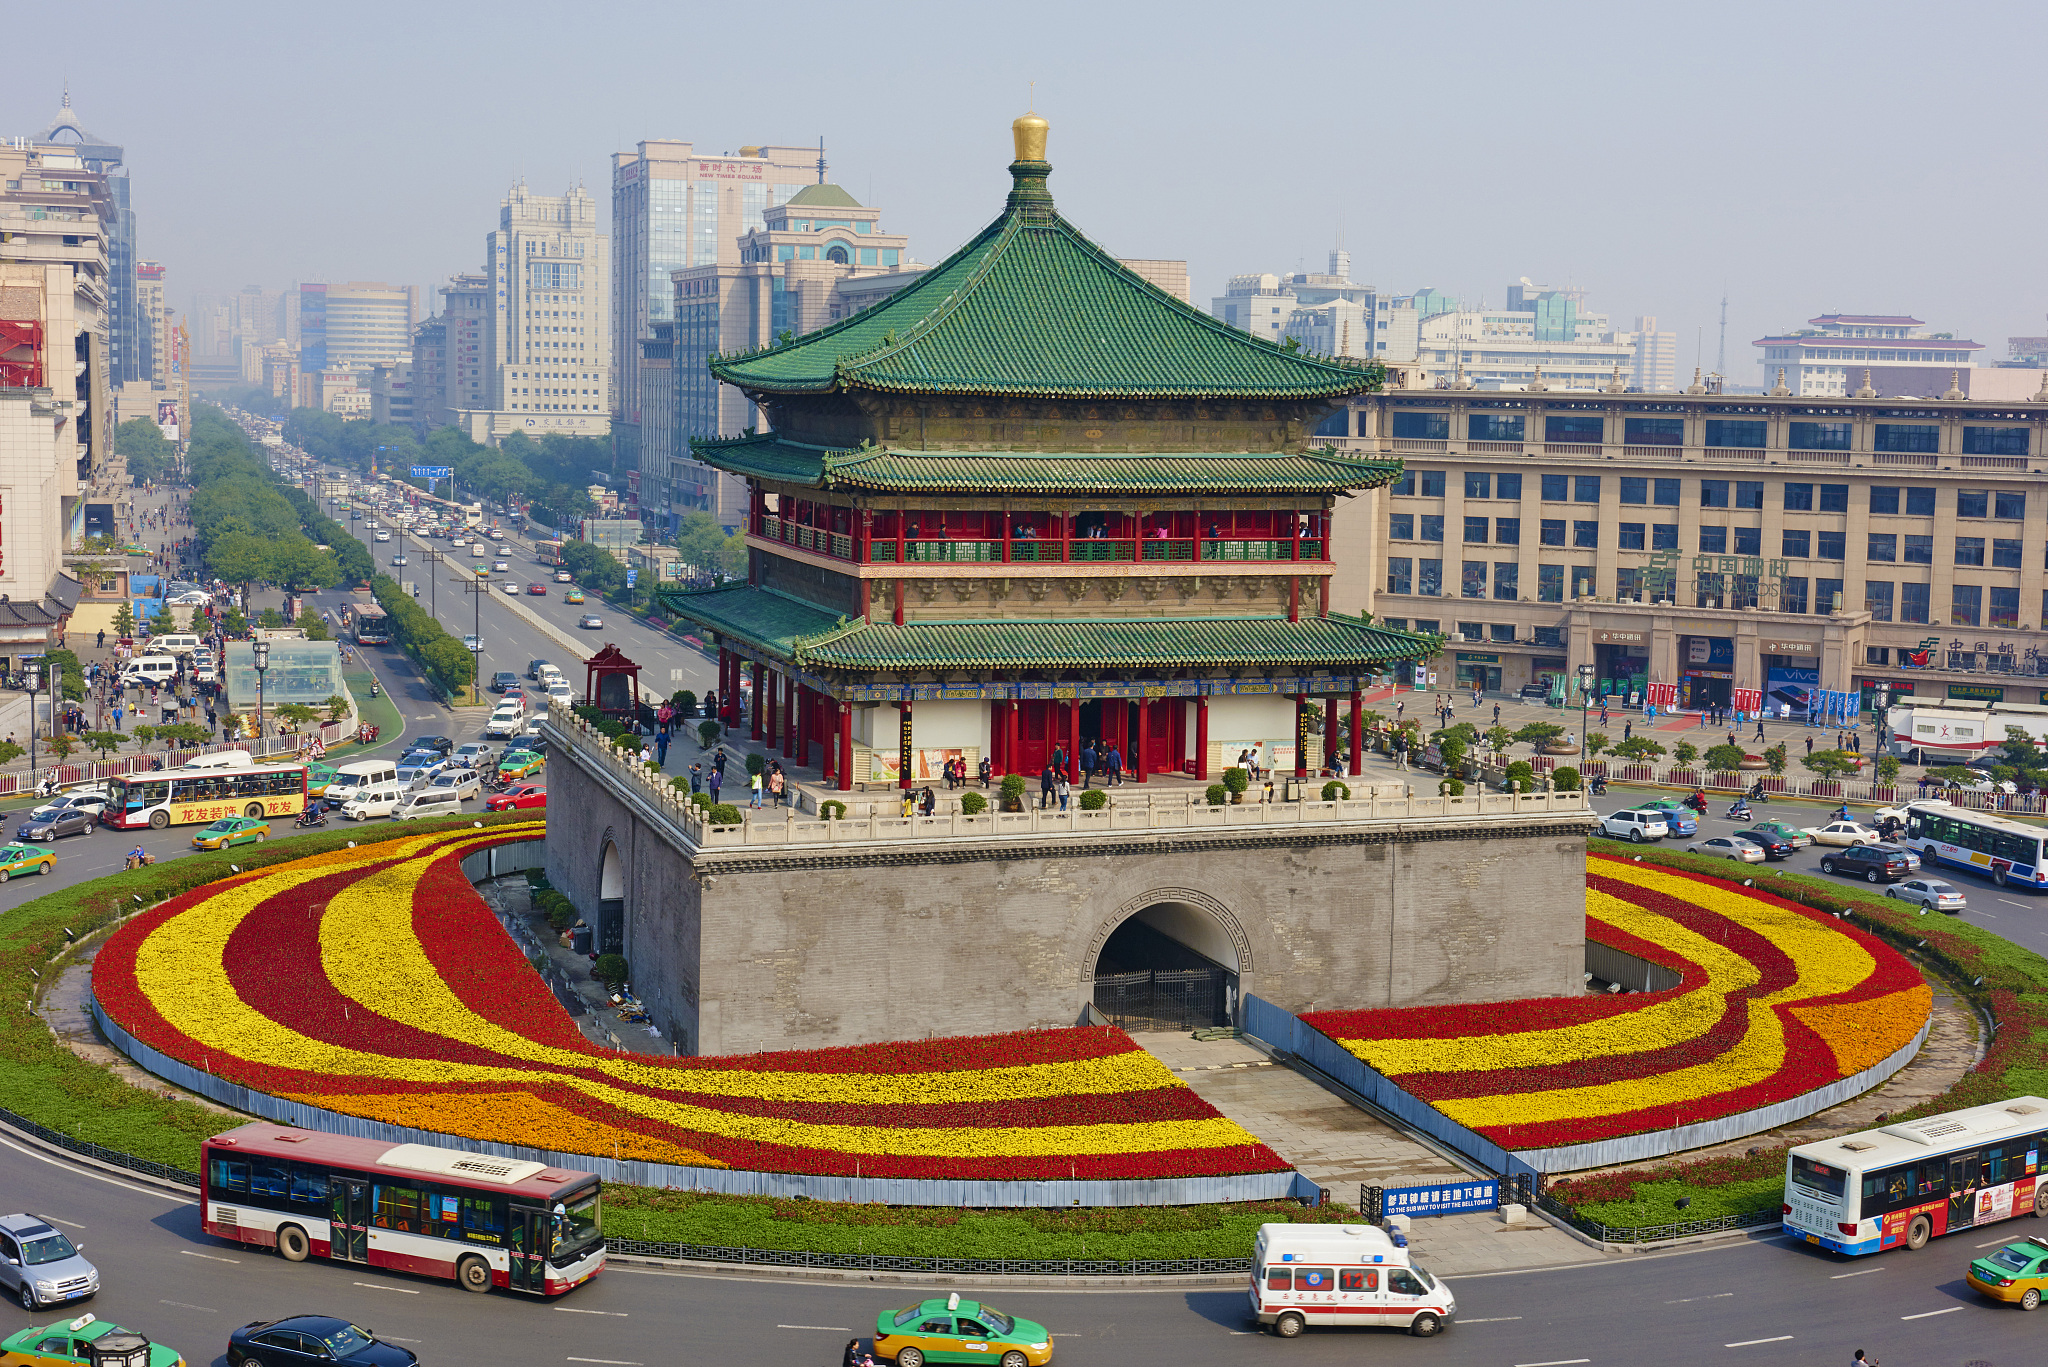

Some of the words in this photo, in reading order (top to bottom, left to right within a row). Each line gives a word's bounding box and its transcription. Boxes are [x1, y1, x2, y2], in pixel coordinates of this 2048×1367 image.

[700, 163, 762, 174] 新时代广场
[498, 262, 506, 311] 交通银行
[544, 418, 586, 426] 交通银行
[1692, 554, 1790, 579] 中国邮政
[1691, 580, 1741, 597] CHINA
[1745, 582, 1790, 597] POST
[1612, 633, 1641, 641] 华中通讯
[1781, 643, 1812, 652] 华中通讯
[1949, 638, 2039, 659] 中国邮政
[1785, 669, 1819, 680] vivo
[181, 805, 237, 822] 龙发装饰
[267, 802, 291, 814] 龙发
[1941, 844, 1958, 853] 巴士股份
[1388, 1186, 1493, 1207] 参观钟楼请走地下通道
[1342, 1273, 1378, 1288] 120
[1282, 1293, 1364, 1302] 西安急救中心
